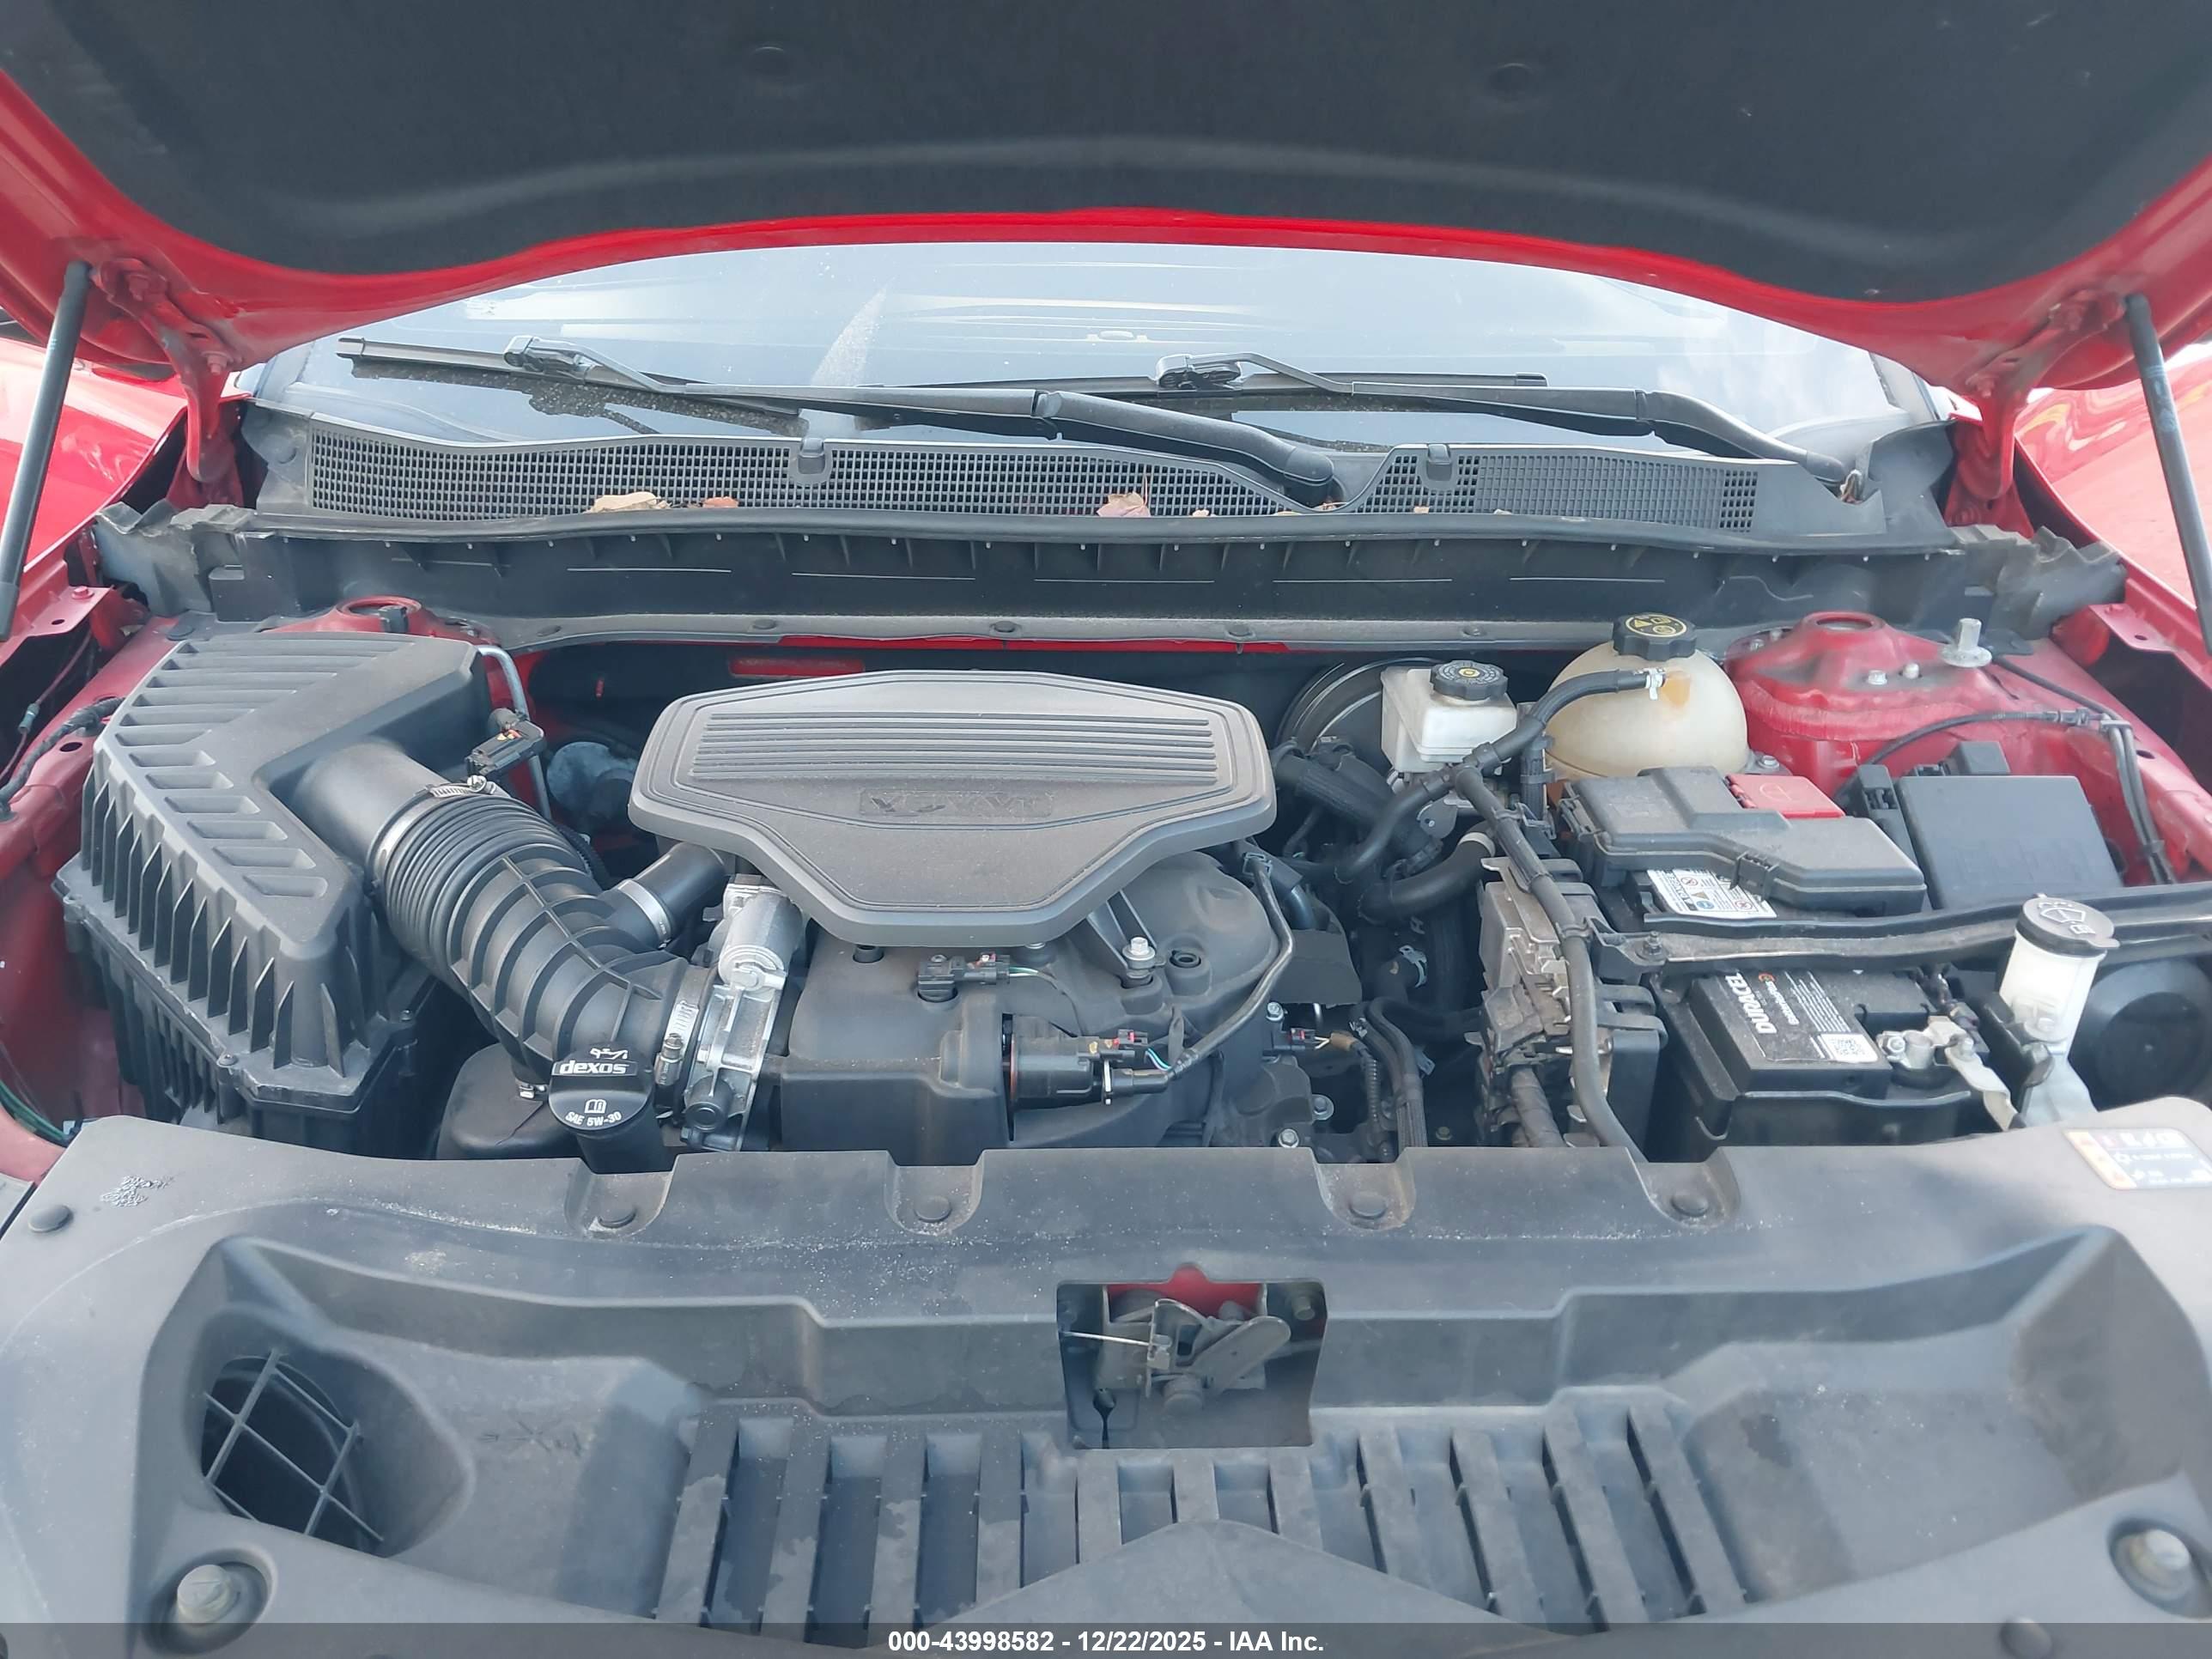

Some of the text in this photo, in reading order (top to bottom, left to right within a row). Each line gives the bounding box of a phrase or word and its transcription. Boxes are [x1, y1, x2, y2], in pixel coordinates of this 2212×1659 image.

[1724, 971, 1778, 1034] DURACEL
[559, 1060, 629, 1074] dexos
[565, 1111, 623, 1127] SAE 5W-30
